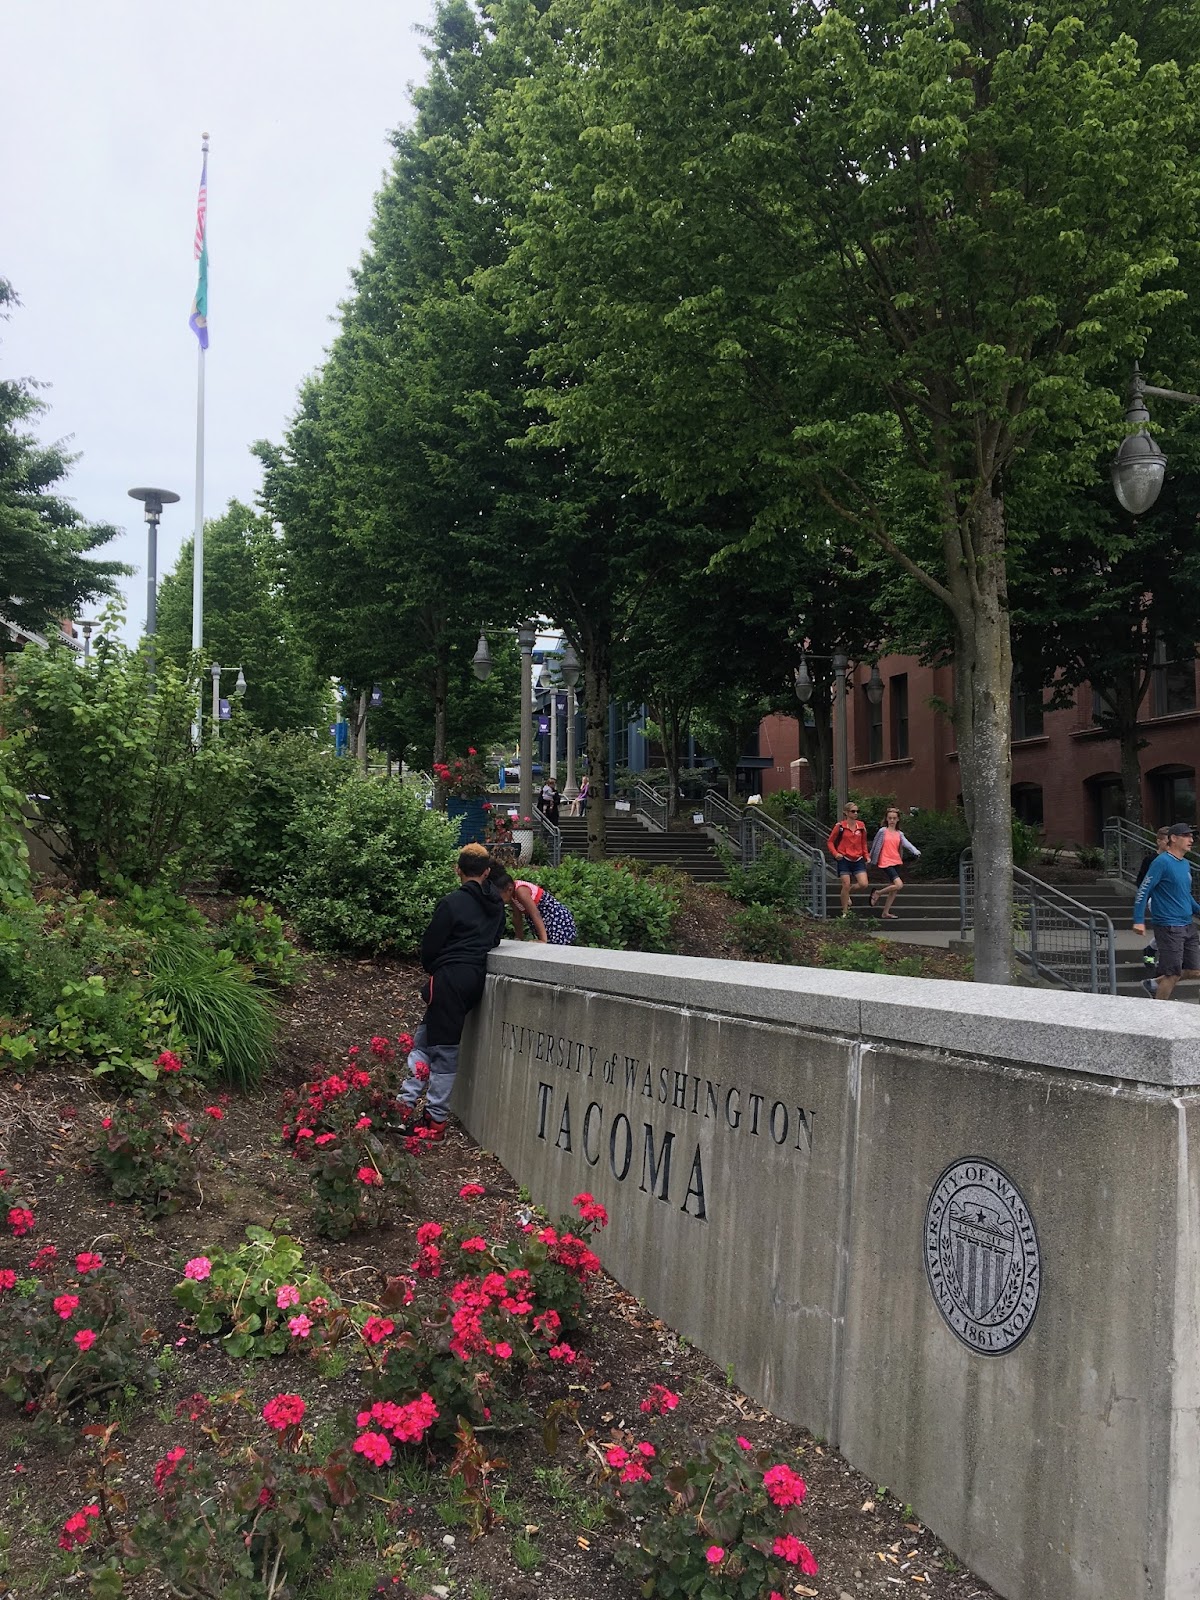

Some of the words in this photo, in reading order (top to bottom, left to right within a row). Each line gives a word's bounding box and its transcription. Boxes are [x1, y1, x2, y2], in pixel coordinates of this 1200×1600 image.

[501, 1021, 598, 1077] UNIVERSITY
[603, 1053, 618, 1084] of
[624, 1056, 816, 1152] WASHINGTON
[537, 1081, 708, 1221] TACOMA
[929, 1172, 960, 1317] UNIVERSITY
[965, 1166, 988, 1181] OF
[996, 1175, 1039, 1343] WASHINGTON
[961, 1321, 995, 1347] 1861
